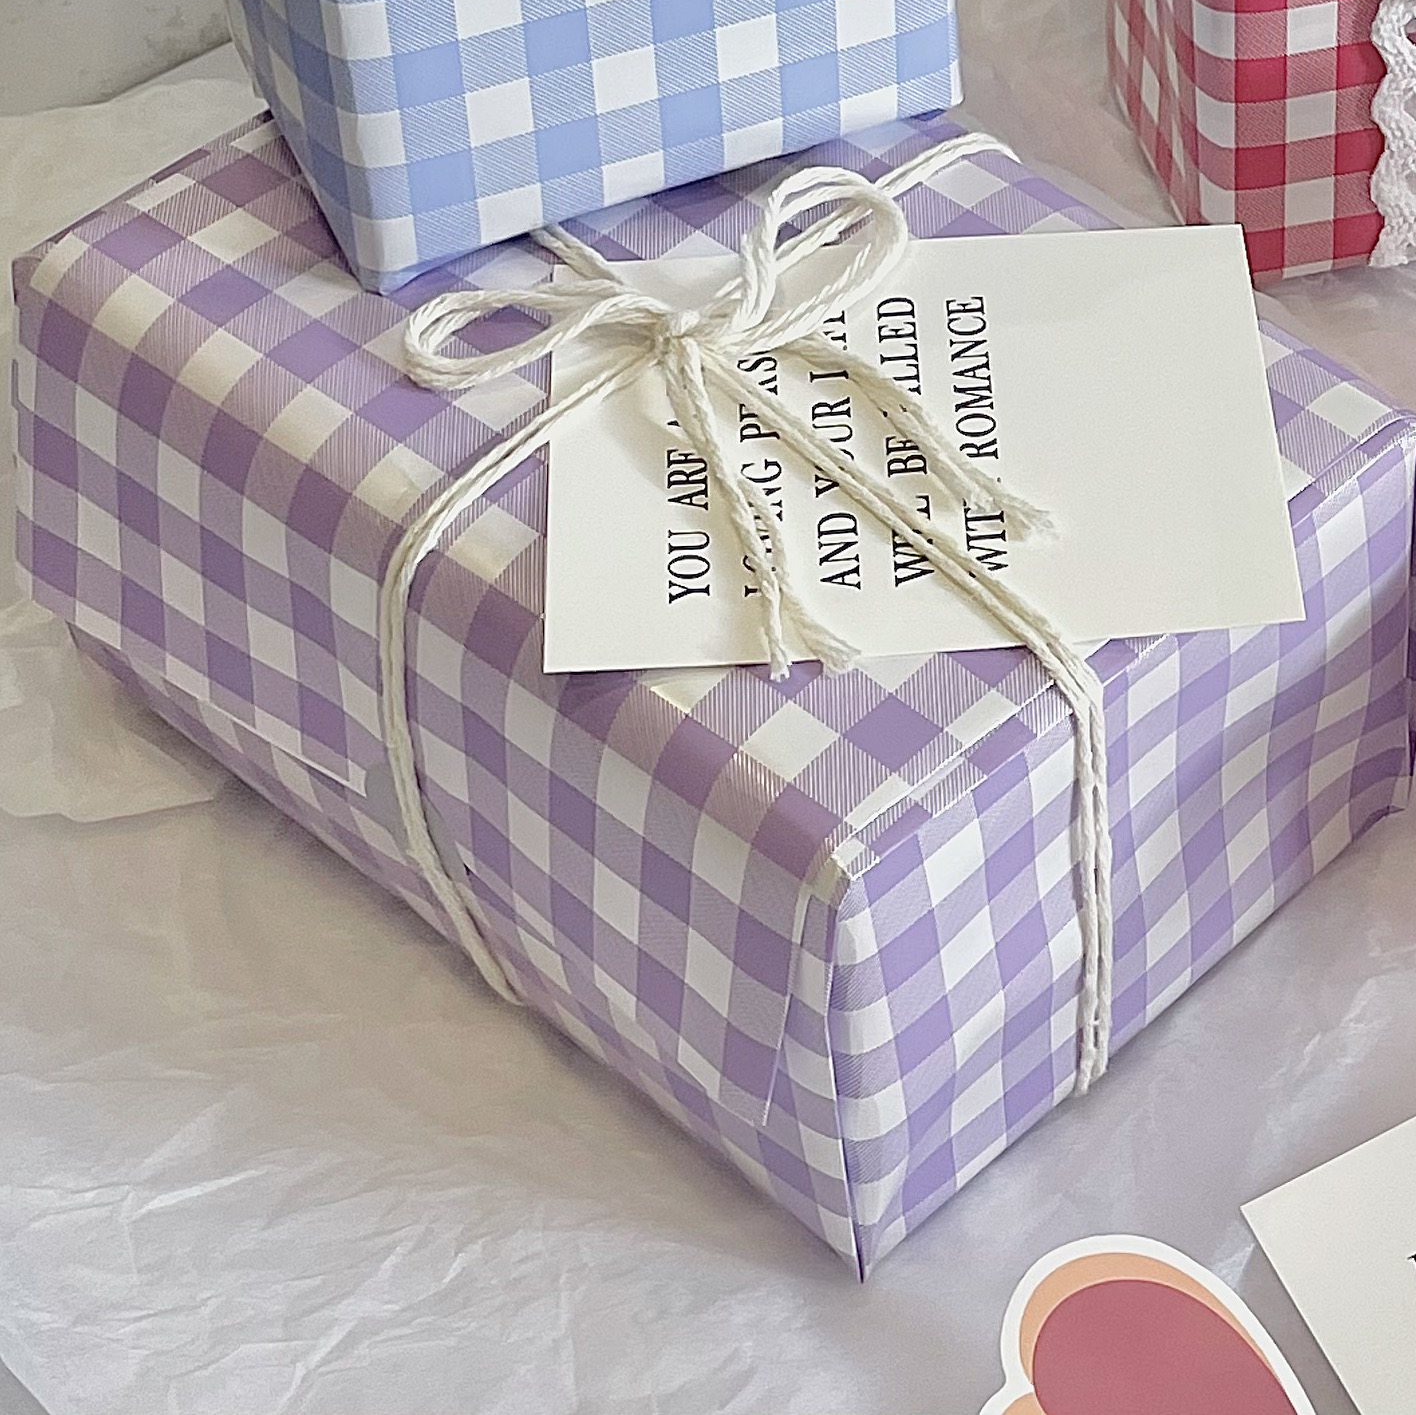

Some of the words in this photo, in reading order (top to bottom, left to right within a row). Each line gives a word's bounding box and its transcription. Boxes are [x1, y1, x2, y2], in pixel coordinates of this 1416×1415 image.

[945, 296, 1000, 460] ROMANCE
[667, 530, 711, 604] YOU
[816, 513, 862, 590] AND
[962, 478, 1009, 578] WIT
